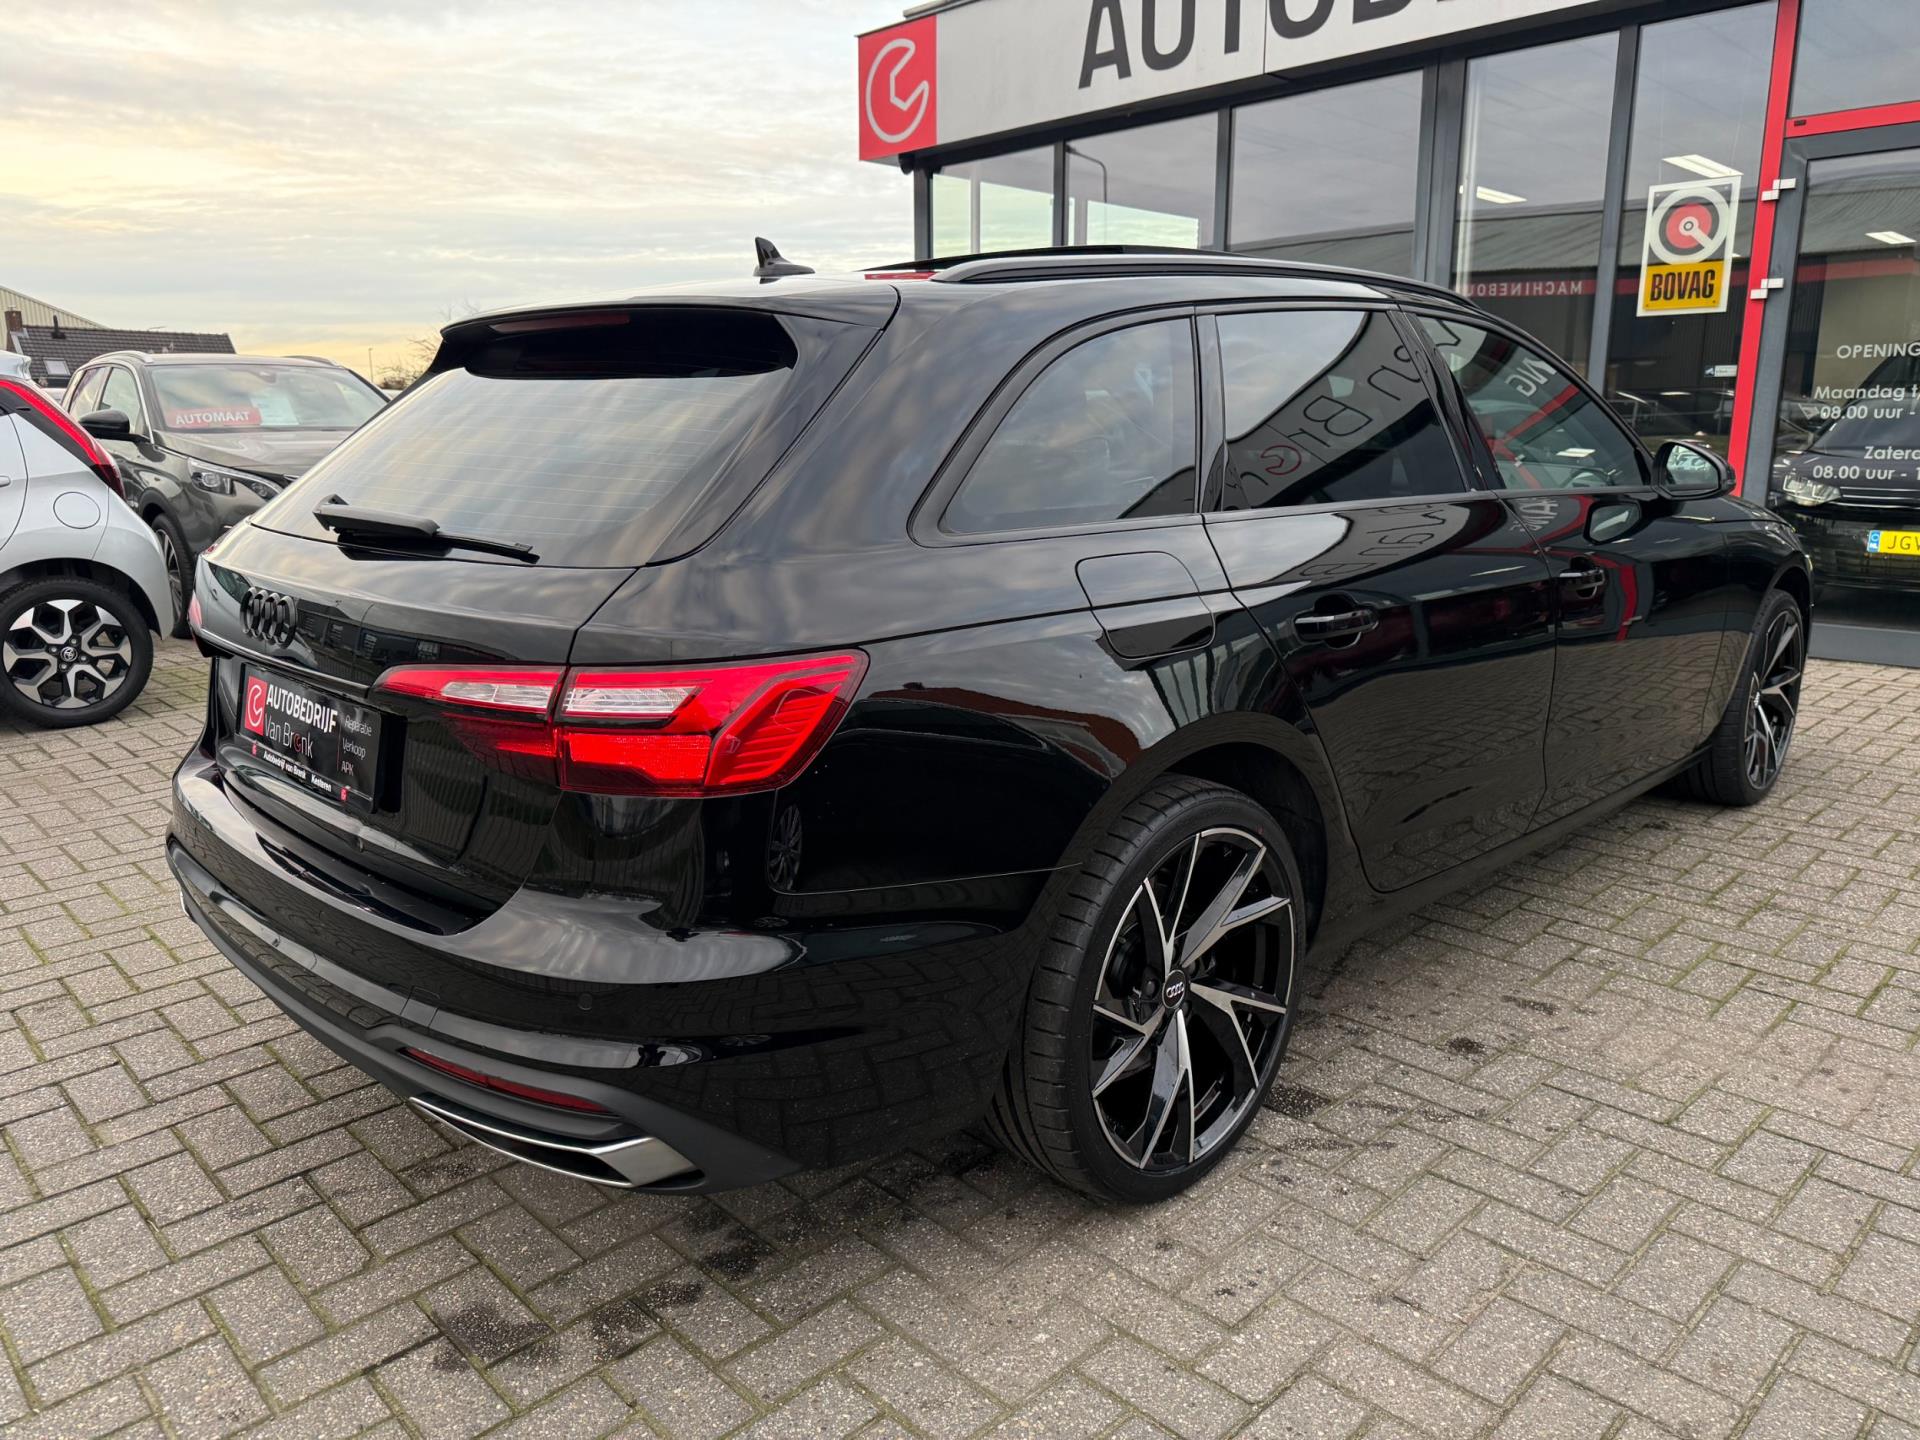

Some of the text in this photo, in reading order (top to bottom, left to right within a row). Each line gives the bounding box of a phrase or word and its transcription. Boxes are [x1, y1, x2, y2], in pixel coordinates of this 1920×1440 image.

[1650, 269, 1716, 302] BOVAG
[1814, 384, 1906, 402] Maandag
[175, 411, 250, 425] AUTOMAAT
[1820, 405, 1868, 420] 08.00
[1873, 406, 1904, 419] uur
[1812, 465, 1860, 479] 08.00
[1865, 468, 1896, 480] uur
[266, 684, 338, 733] AUTOBEDRIJF
[264, 713, 281, 742] Van
[344, 714, 372, 737] Reparatie
[342, 737, 366, 761] Verkoop
[263, 750, 286, 771] Autobedrijf
[341, 760, 354, 776] APK
